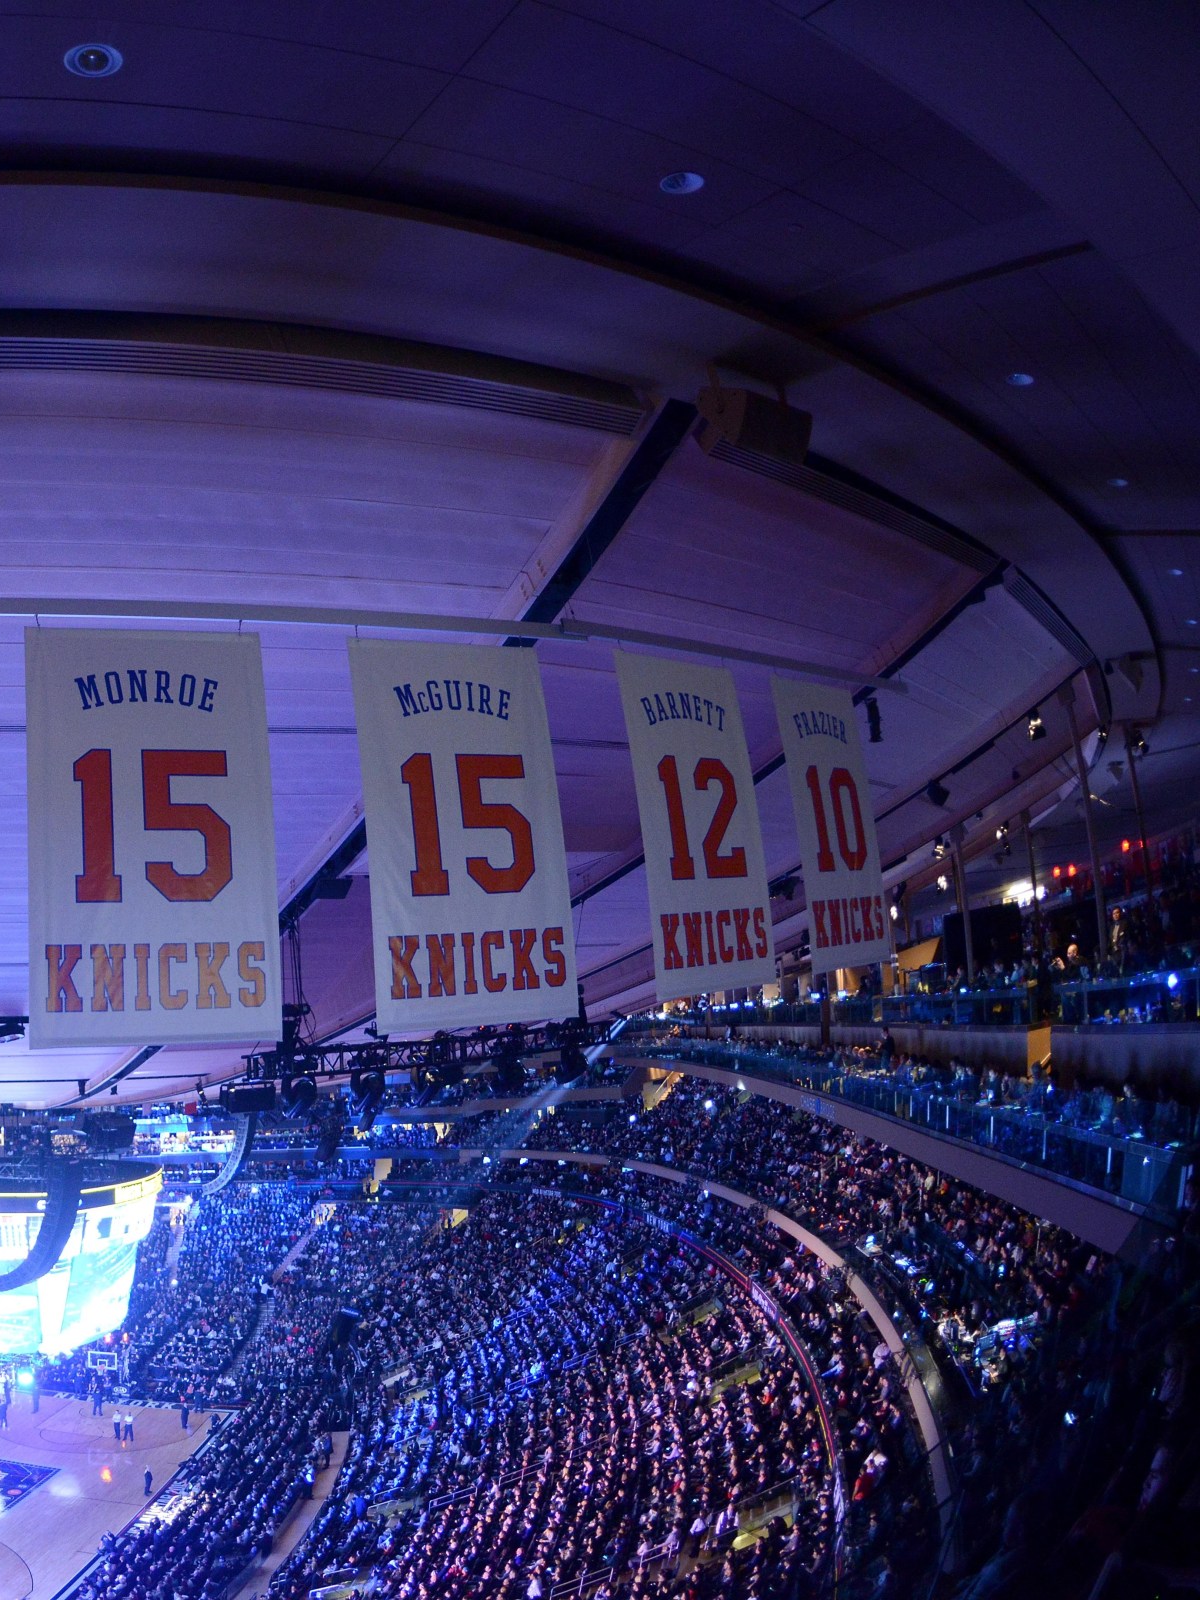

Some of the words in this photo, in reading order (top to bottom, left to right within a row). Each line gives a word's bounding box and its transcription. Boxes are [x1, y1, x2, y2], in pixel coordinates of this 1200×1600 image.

[74, 669, 219, 713] MONROE
[393, 681, 512, 721] McGUIRE
[640, 692, 726, 732] BARNETT
[793, 709, 848, 745] FRAZIER
[73, 748, 234, 904] 15
[400, 752, 537, 897] 15
[657, 755, 749, 881] 12
[805, 764, 868, 873] 10
[660, 906, 769, 972] KNICKS
[811, 895, 886, 949] KNICKS
[45, 941, 266, 1013] KNICKS
[388, 926, 567, 1000] KNICKS
